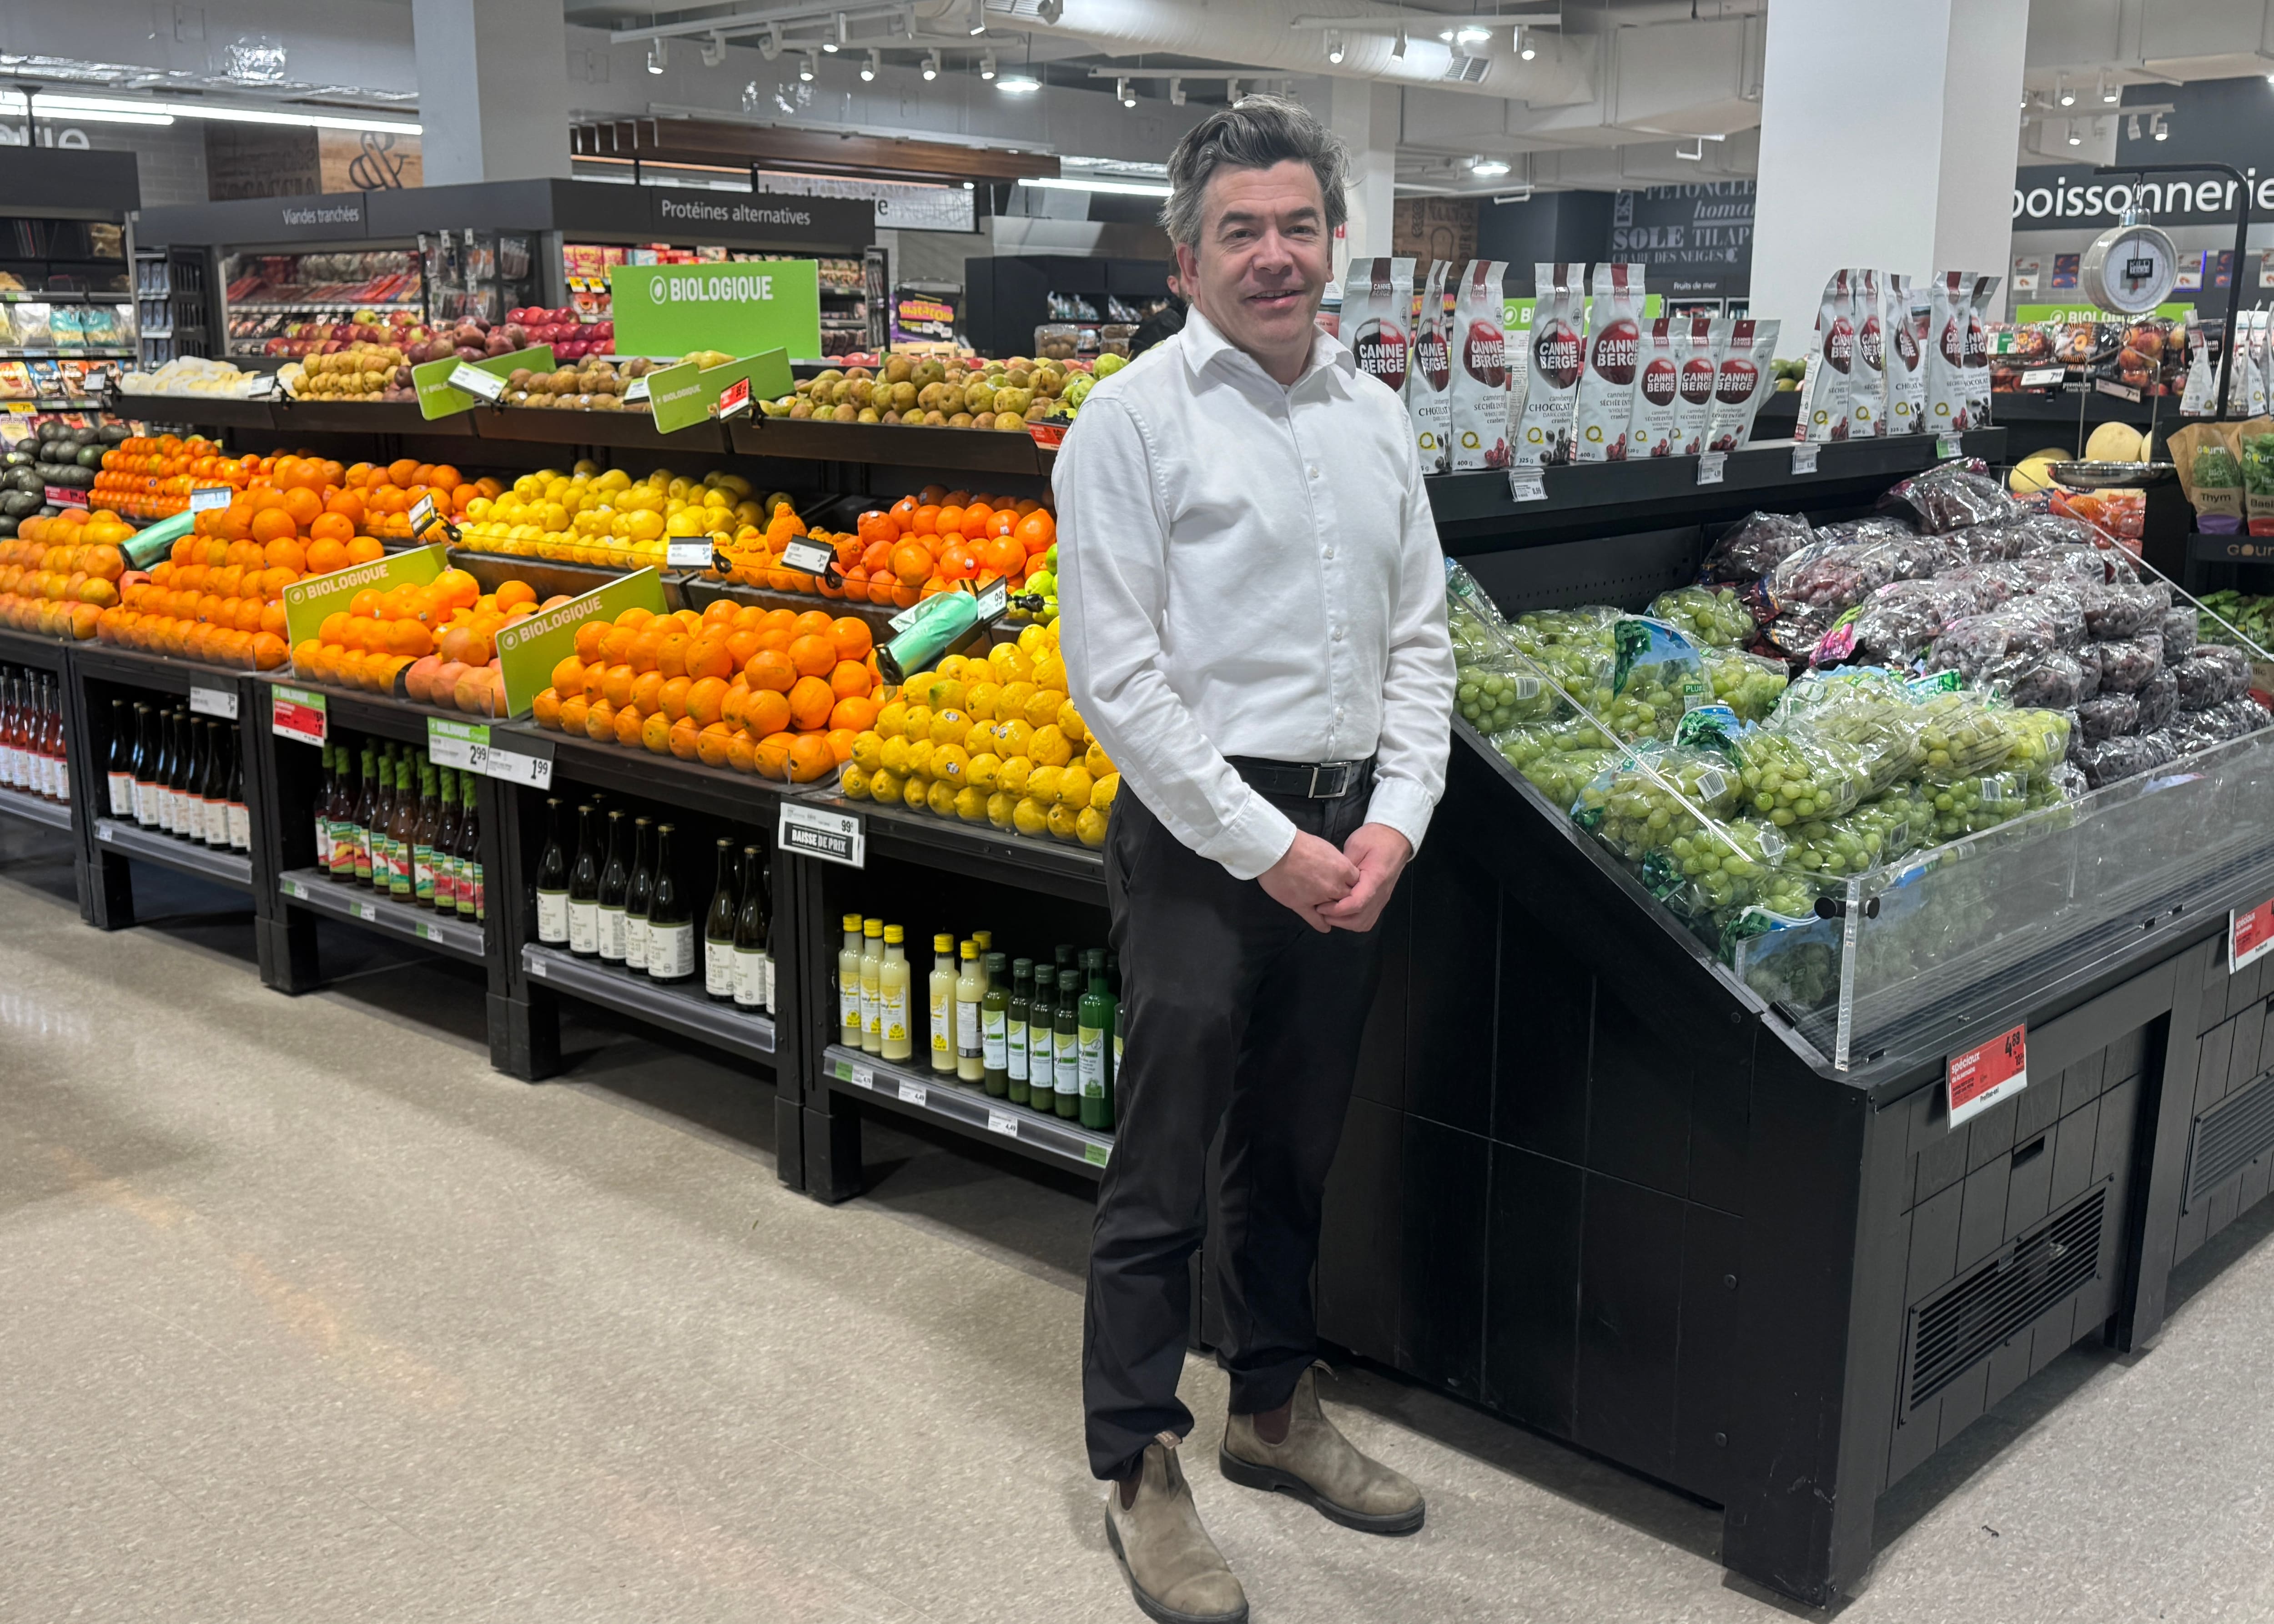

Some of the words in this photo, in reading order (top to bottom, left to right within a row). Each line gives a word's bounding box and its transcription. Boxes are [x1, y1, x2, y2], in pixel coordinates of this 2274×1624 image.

[282, 207, 316, 225] Viandes
[318, 205, 359, 224] tranchées
[661, 199, 728, 221] Protéines
[732, 204, 811, 226] alternatives
[1612, 226, 1684, 250] SOLE
[669, 276, 773, 303] BIOLOGIQUE
[1358, 343, 1404, 359] CANNE
[1471, 340, 1504, 354] CANNE
[1539, 341, 1577, 355] CANNE
[1361, 358, 1404, 374] BERGE
[1471, 354, 1505, 368] BERGE
[1539, 355, 1578, 369] BERGE
[1647, 373, 1675, 382] CANNE
[1682, 372, 1713, 382] CANNE
[1718, 372, 1755, 382] CANNE
[662, 384, 701, 403] BIOLOGIQUE
[1647, 383, 1675, 392] BERGE
[1682, 382, 1712, 392] BERGE
[2201, 493, 2231, 503] Thym
[306, 563, 390, 600] BIOLOGIQUE
[519, 595, 603, 643] BIOLOGIQUE
[791, 829, 817, 846] BAISSE
[818, 835, 828, 849] DE
[828, 837, 846, 853] PRIX
[1951, 1051, 1980, 1075] spéciaux
